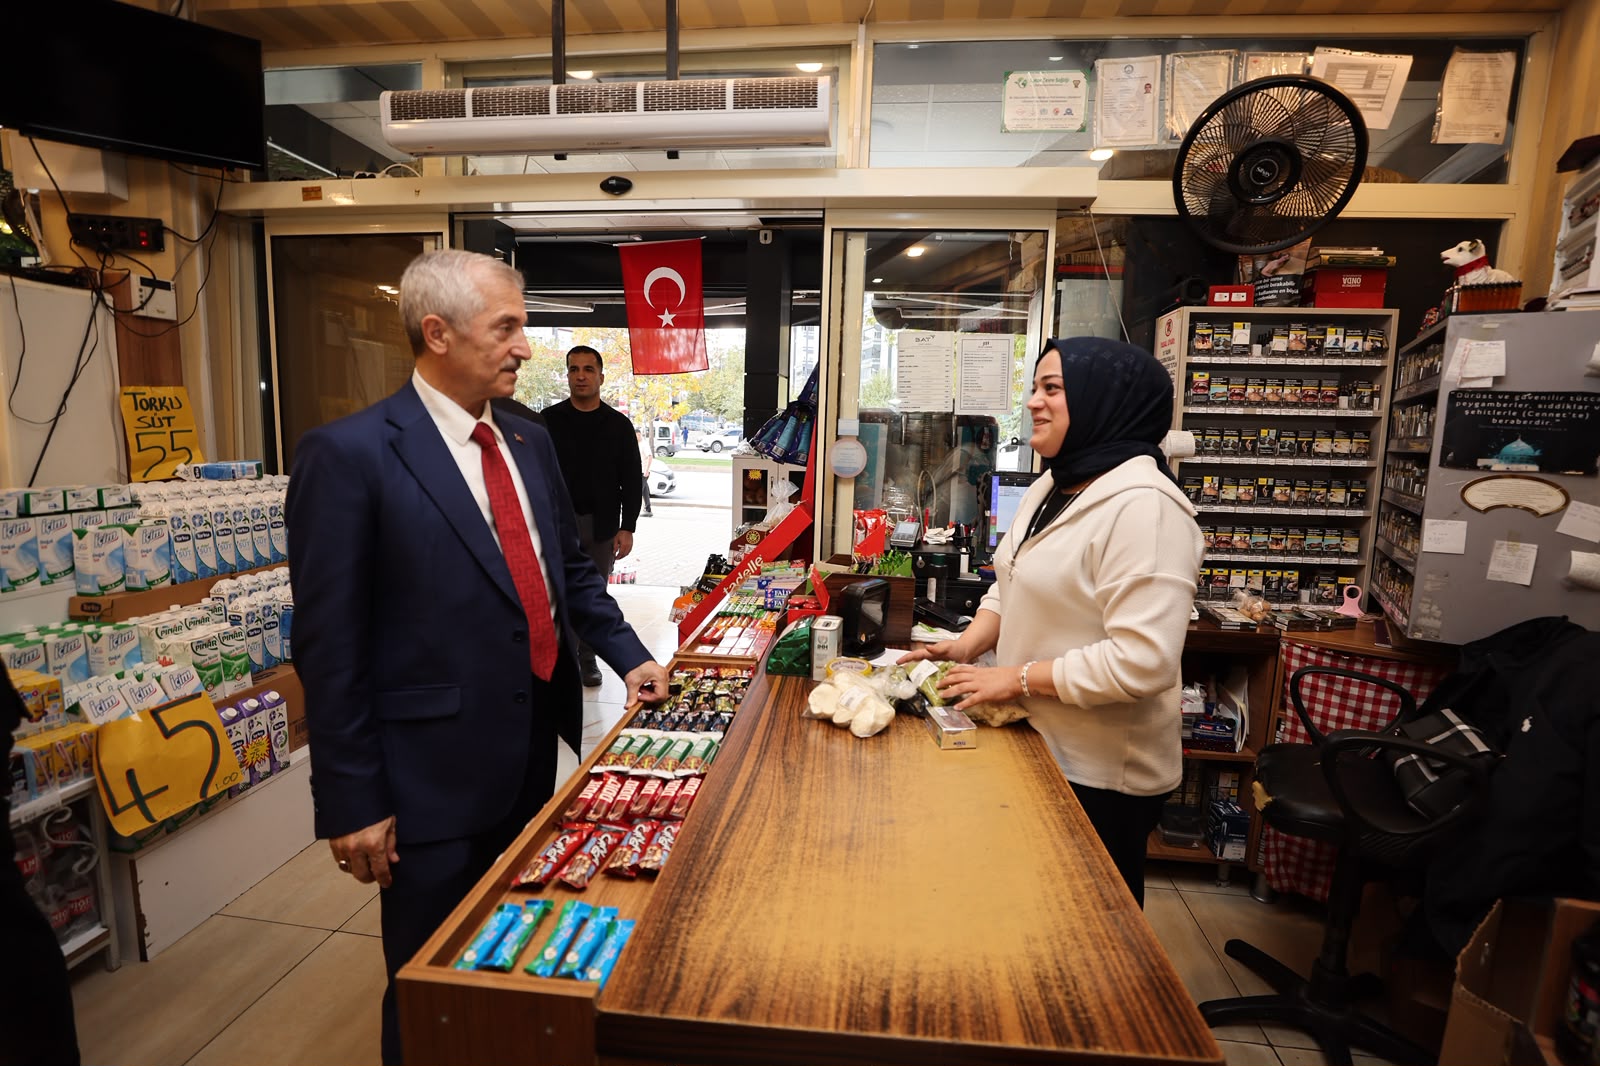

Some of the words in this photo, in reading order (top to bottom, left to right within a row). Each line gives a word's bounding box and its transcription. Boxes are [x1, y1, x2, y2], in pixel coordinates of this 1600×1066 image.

[124, 392, 182, 412] TORKU
[134, 412, 176, 429] SÜT
[135, 429, 192, 478] 55
[722, 554, 764, 596] tadelle
